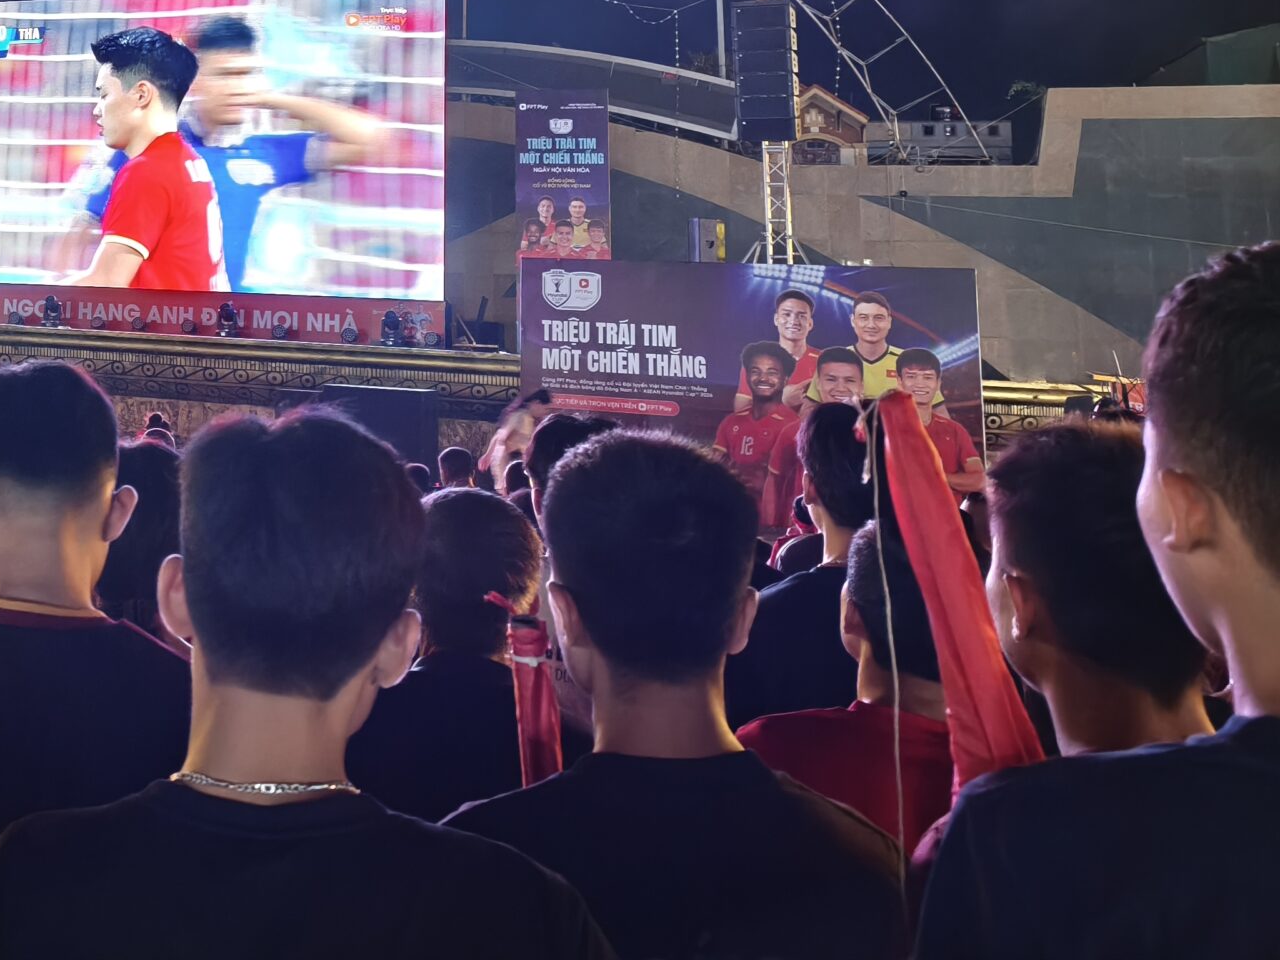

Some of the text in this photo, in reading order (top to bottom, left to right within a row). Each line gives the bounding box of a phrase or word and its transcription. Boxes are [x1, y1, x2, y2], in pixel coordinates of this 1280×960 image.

[383, 14, 407, 25] Play
[19, 27, 40, 40] THA
[526, 136, 597, 151] TRIỆU TRÁI TIM
[519, 150, 605, 165] MỘT CHIẾN THẮNG
[4, 298, 71, 318] NGOI
[146, 305, 194, 325] ANH
[201, 302, 245, 328] ĐN
[306, 308, 359, 333] NHÀ
[542, 317, 677, 348] TRIỆU TRÁI TIM
[542, 345, 707, 379] MỘT CHIẾN THẮNG
[740, 436, 754, 455] 12
